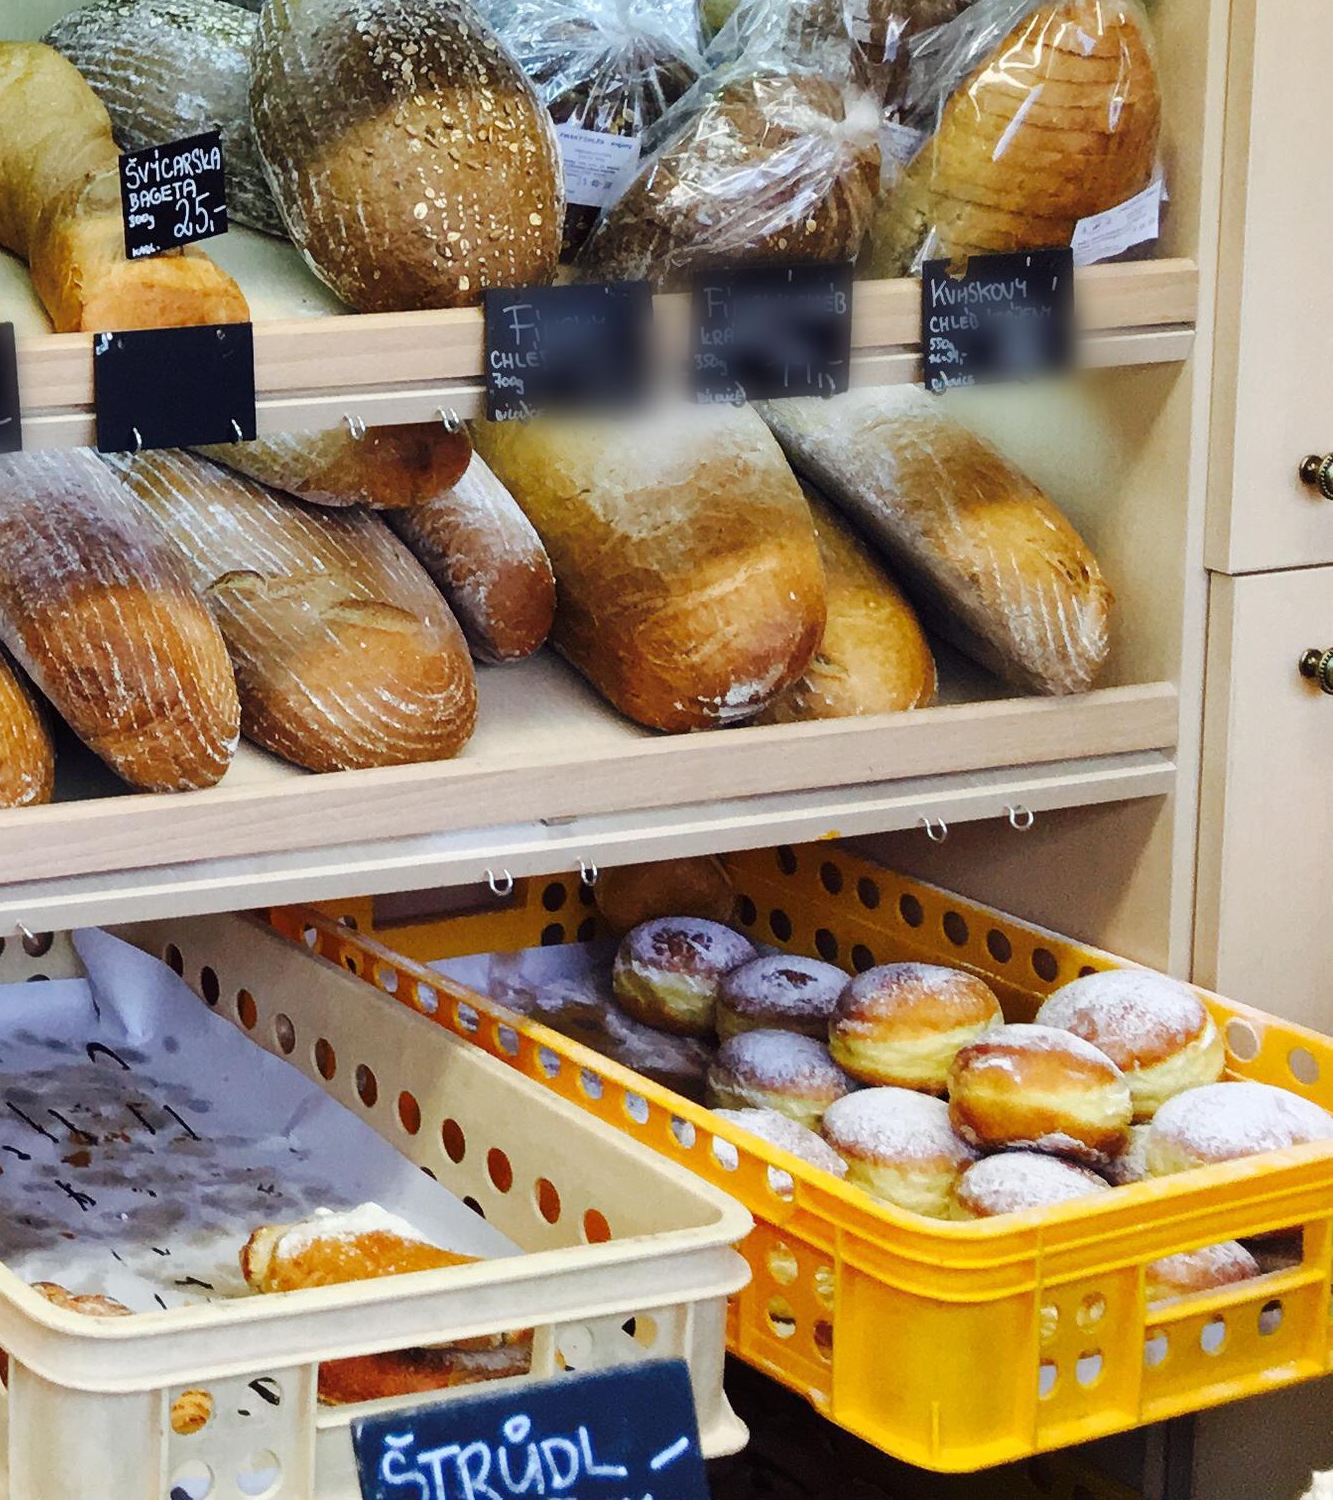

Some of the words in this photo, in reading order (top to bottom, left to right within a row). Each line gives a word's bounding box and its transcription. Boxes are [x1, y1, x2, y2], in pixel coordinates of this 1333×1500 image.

[128, 178, 197, 213] BAGETA
[173, 192, 227, 238] 25,-
[382, 1414, 628, 1500] ŠTRŮDL
